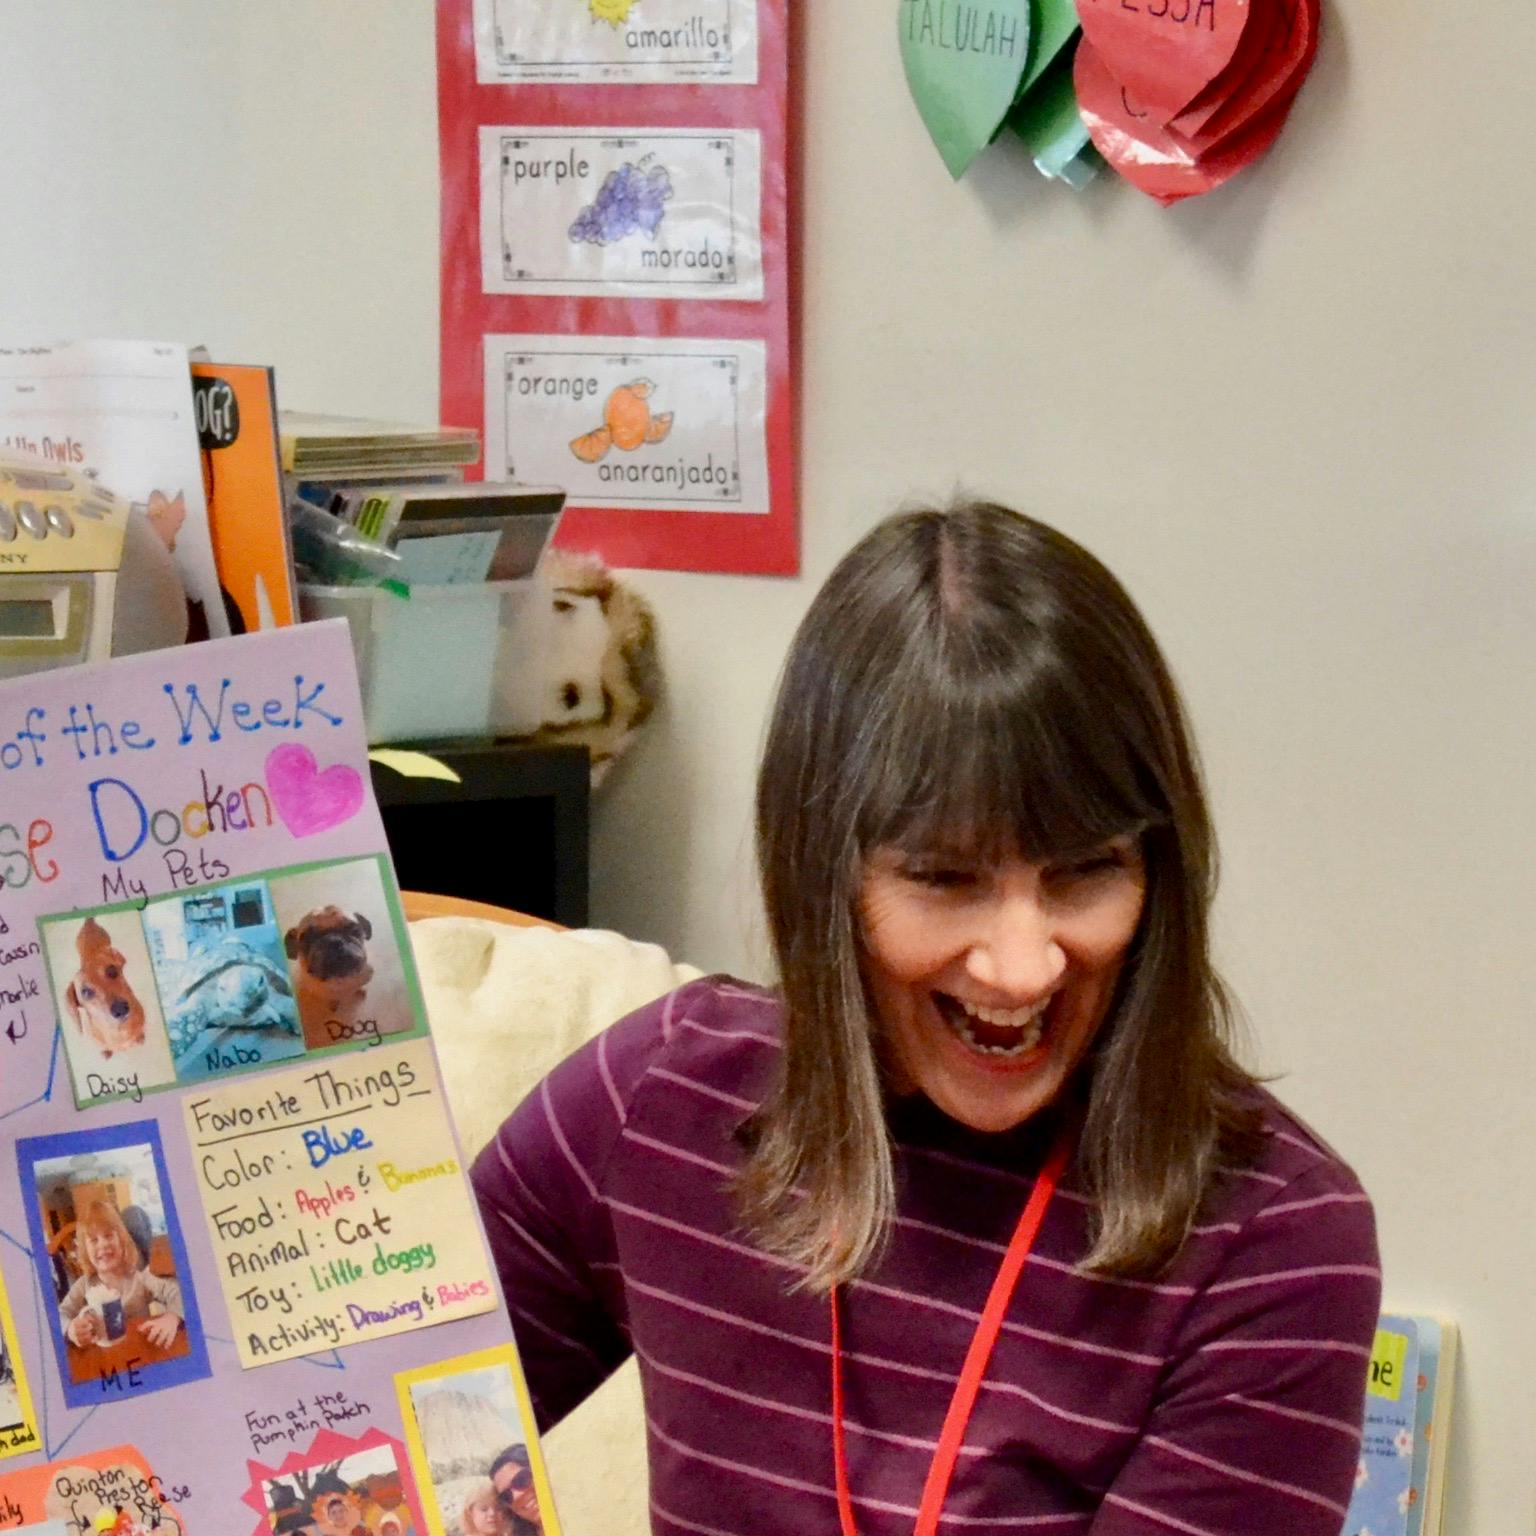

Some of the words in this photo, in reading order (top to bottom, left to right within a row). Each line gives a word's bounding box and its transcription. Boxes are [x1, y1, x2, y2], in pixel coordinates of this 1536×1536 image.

[626, 16, 719, 49] amarillo
[514, 148, 589, 186] purple
[641, 235, 722, 268] morado
[518, 376, 598, 401] orange
[599, 454, 728, 490] anaranjado
[0, 708, 46, 767] of
[61, 703, 156, 758] the
[163, 675, 342, 744] Week
[88, 769, 274, 863] Docken
[101, 871, 150, 911] My
[163, 849, 230, 890] Pets
[87, 1073, 144, 1103] Daisy
[205, 1048, 262, 1073] Nabo
[326, 1018, 383, 1046] Doug
[190, 1092, 301, 1132] Favorite
[304, 1061, 415, 1108] Things
[302, 1126, 374, 1168] Blue
[295, 1181, 356, 1219] Apples
[334, 1208, 391, 1245] Cat
[372, 1241, 436, 1276] doggy
[345, 1297, 424, 1331] Drawing
[436, 1279, 490, 1307] Babies
[100, 1358, 144, 1393] ME
[245, 1411, 281, 1433] Fun
[285, 1402, 306, 1421] at
[314, 1390, 348, 1411] the
[11, 1424, 35, 1445] dad
[55, 1469, 126, 1499] Quinton
[95, 1476, 164, 1505] Preston
